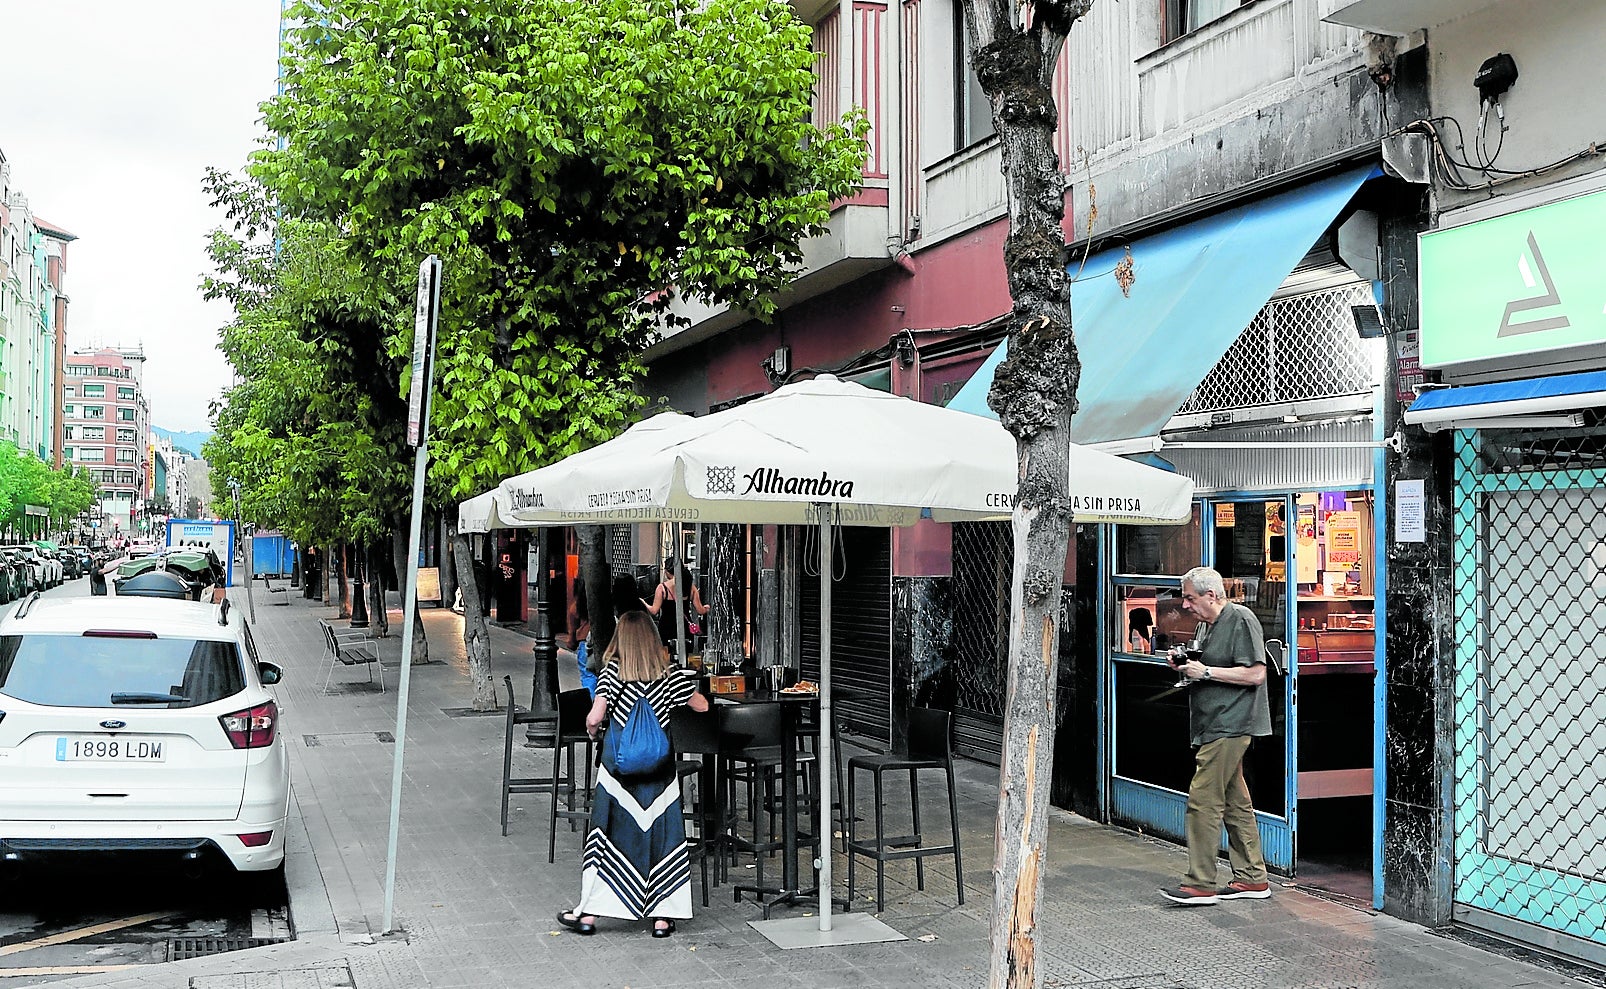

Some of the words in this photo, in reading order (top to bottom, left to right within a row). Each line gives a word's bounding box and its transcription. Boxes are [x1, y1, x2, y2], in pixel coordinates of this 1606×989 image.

[741, 467, 854, 498] Alhambra
[1084, 496, 1103, 510] SIN
[1108, 497, 1141, 511] PRISA
[74, 741, 119, 758] 1898
[126, 742, 162, 759] LDM
